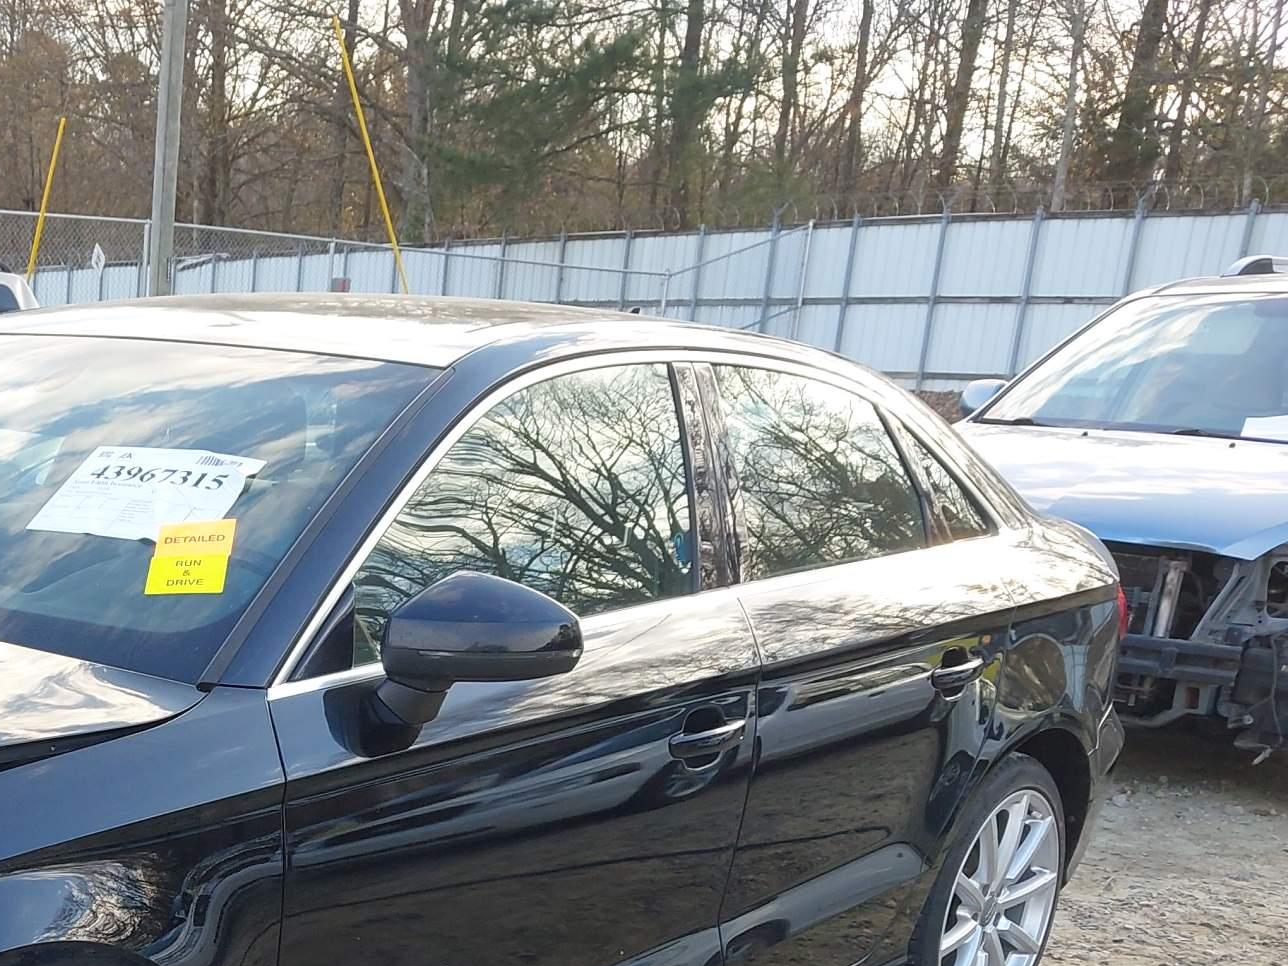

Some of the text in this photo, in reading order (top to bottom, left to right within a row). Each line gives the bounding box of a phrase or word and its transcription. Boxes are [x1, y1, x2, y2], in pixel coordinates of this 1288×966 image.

[90, 464, 230, 491] 43967315
[164, 534, 226, 545] DETAILED
[175, 559, 202, 567] RUN
[182, 569, 191, 577] &
[166, 578, 205, 587] DRIVE
